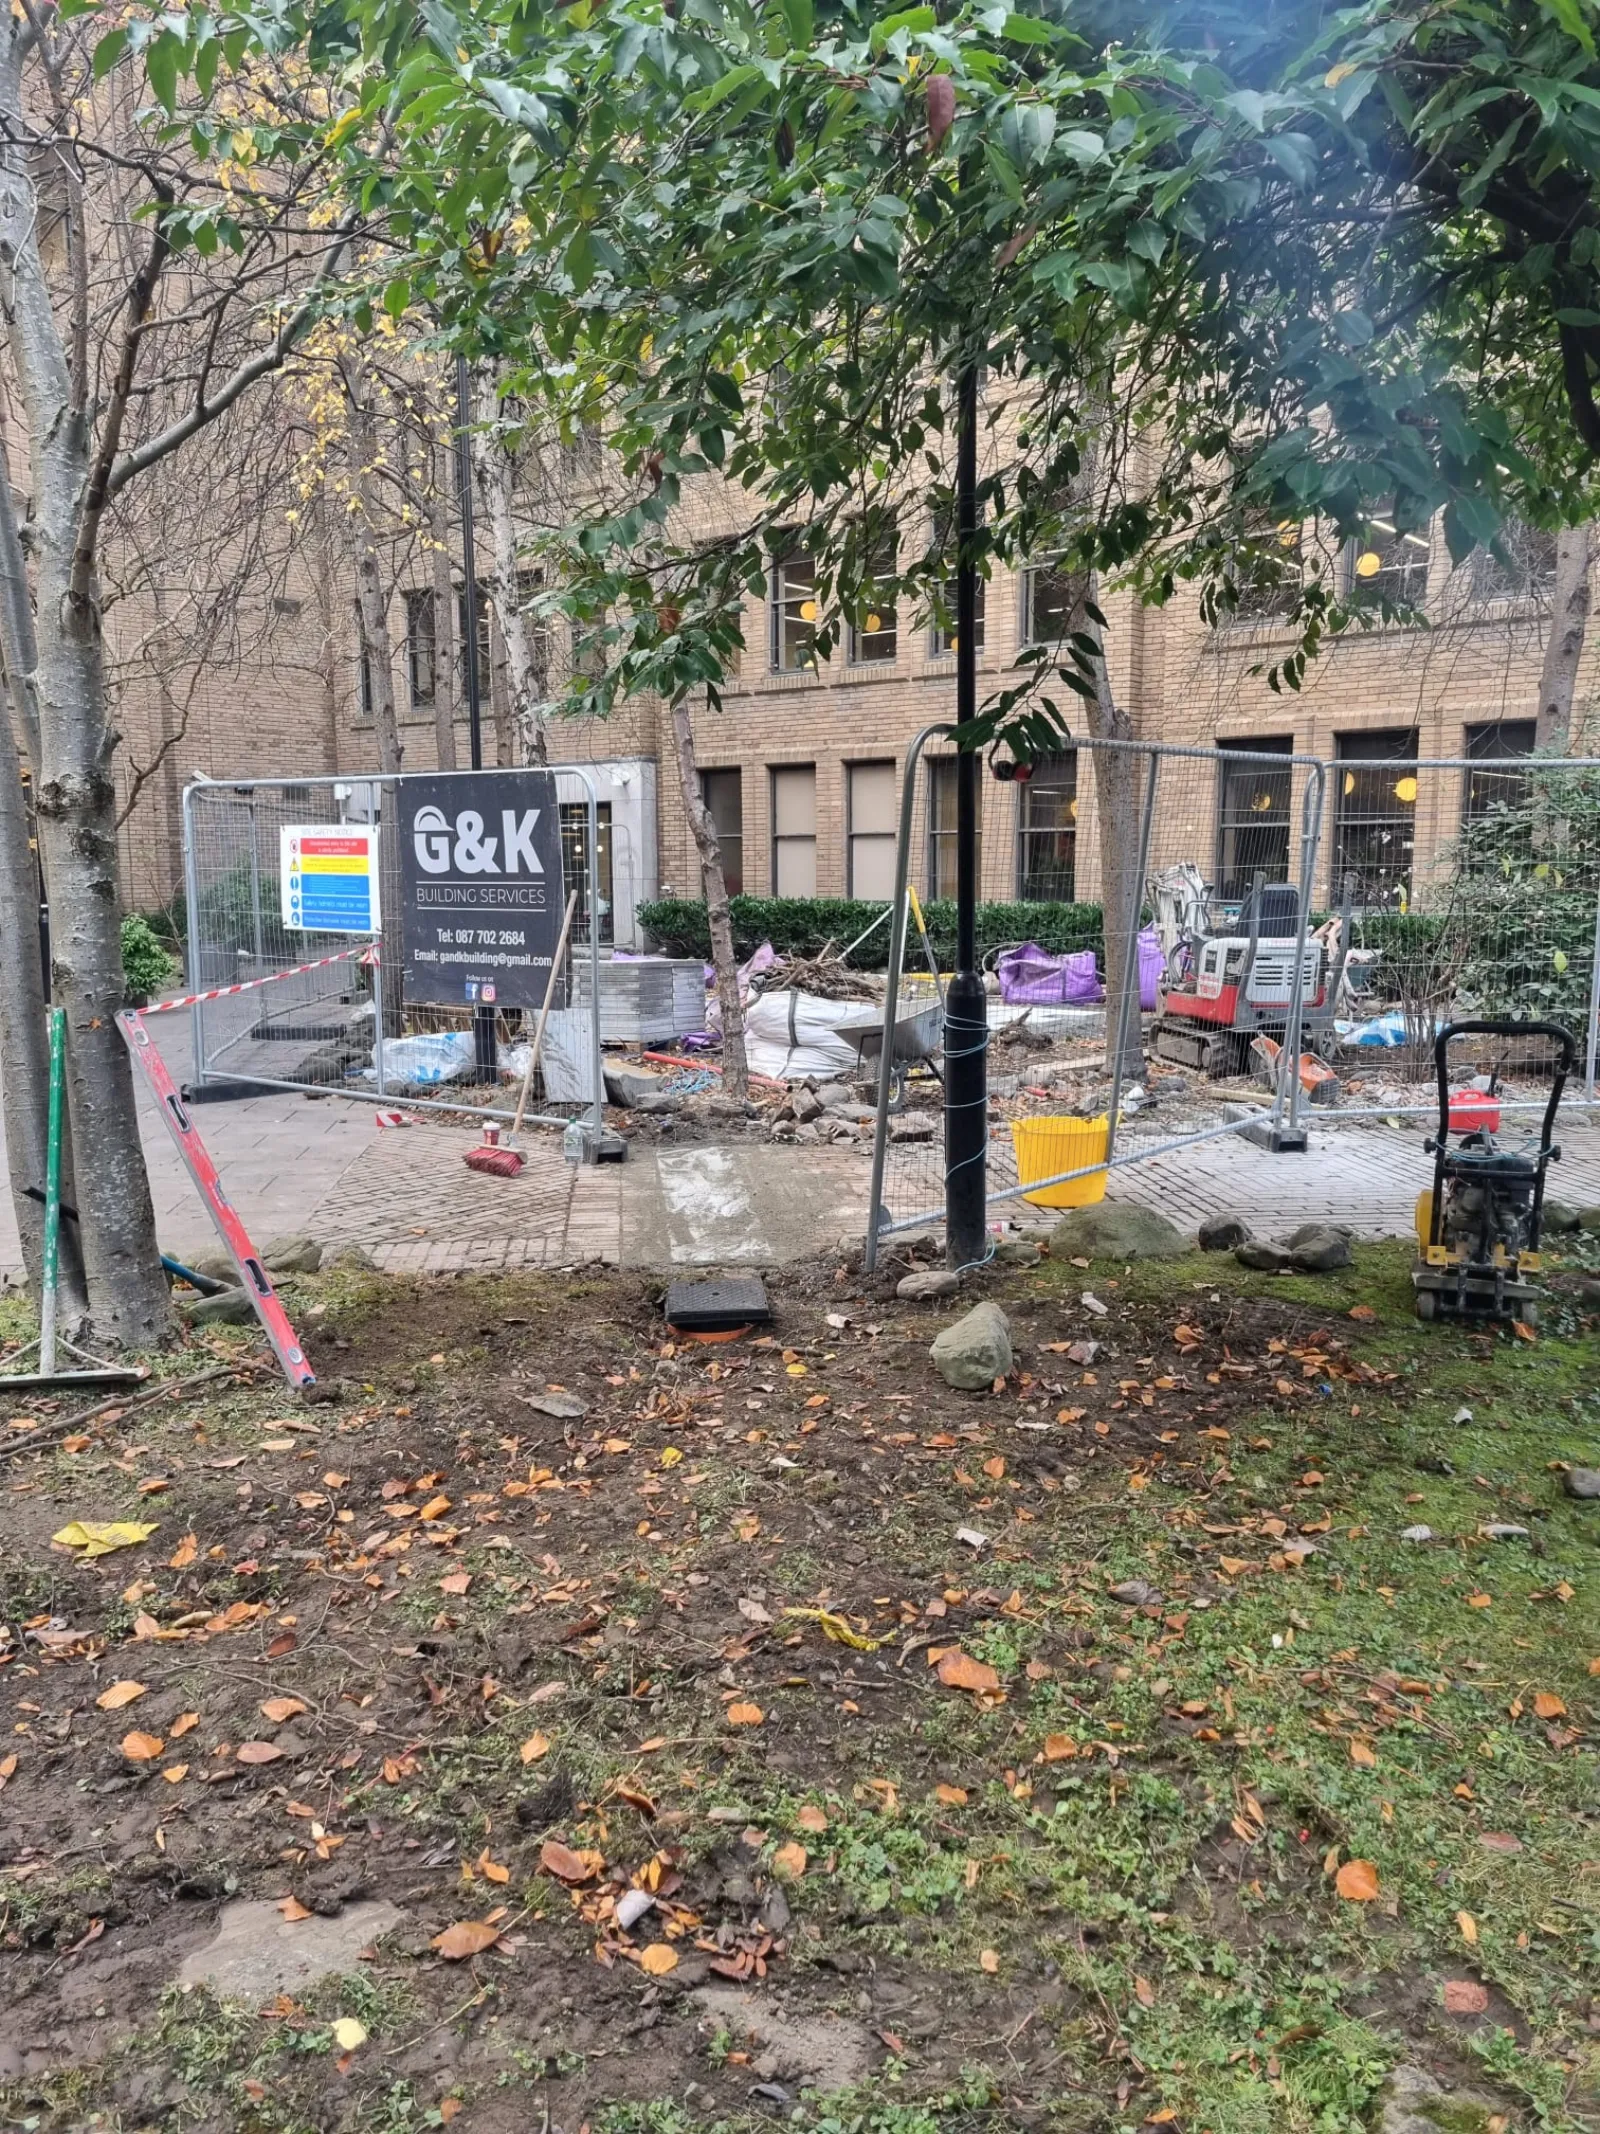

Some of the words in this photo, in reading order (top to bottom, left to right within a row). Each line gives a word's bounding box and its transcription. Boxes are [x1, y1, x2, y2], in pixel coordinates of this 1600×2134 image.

[414, 805, 545, 874] G&K
[416, 887, 477, 903] BUILDING
[480, 888, 546, 904] SERVICES
[437, 928, 454, 943] Tel:
[455, 929, 474, 944] 087
[476, 930, 497, 944] 702
[499, 931, 526, 946] 2684
[414, 948, 438, 962] Email:
[440, 950, 553, 968] gandkbuilding@gmail.com
